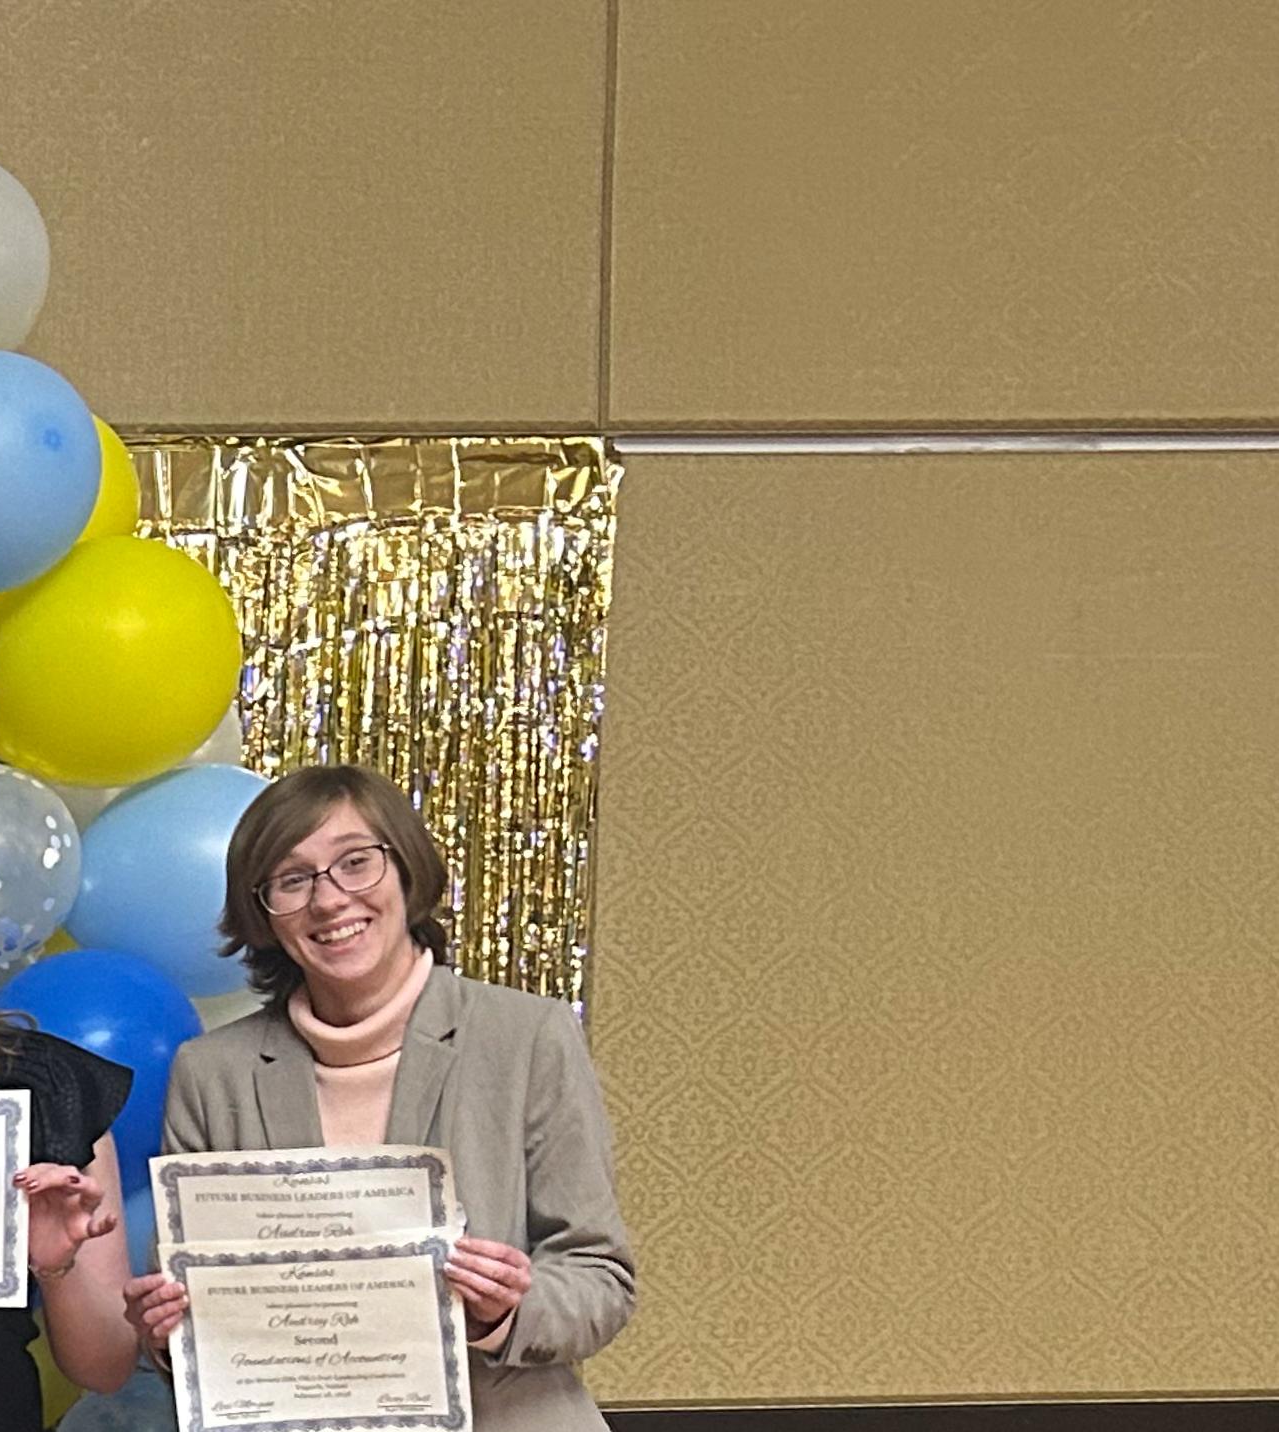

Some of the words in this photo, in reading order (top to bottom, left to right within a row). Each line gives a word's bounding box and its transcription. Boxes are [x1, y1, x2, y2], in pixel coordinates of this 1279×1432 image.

[195, 1193, 238, 1202] FUTURE
[240, 1193, 292, 1202] BUSINESS
[294, 1191, 344, 1201] LEADERS
[346, 1190, 362, 1199] OF
[364, 1188, 415, 1198] AMERICA
[207, 1287, 247, 1296] FUTURE
[250, 1285, 300, 1295] BUSINESS
[302, 1284, 348, 1293] LEADERS
[366, 1280, 415, 1290] AMERICA
[294, 1333, 338, 1346] Second
